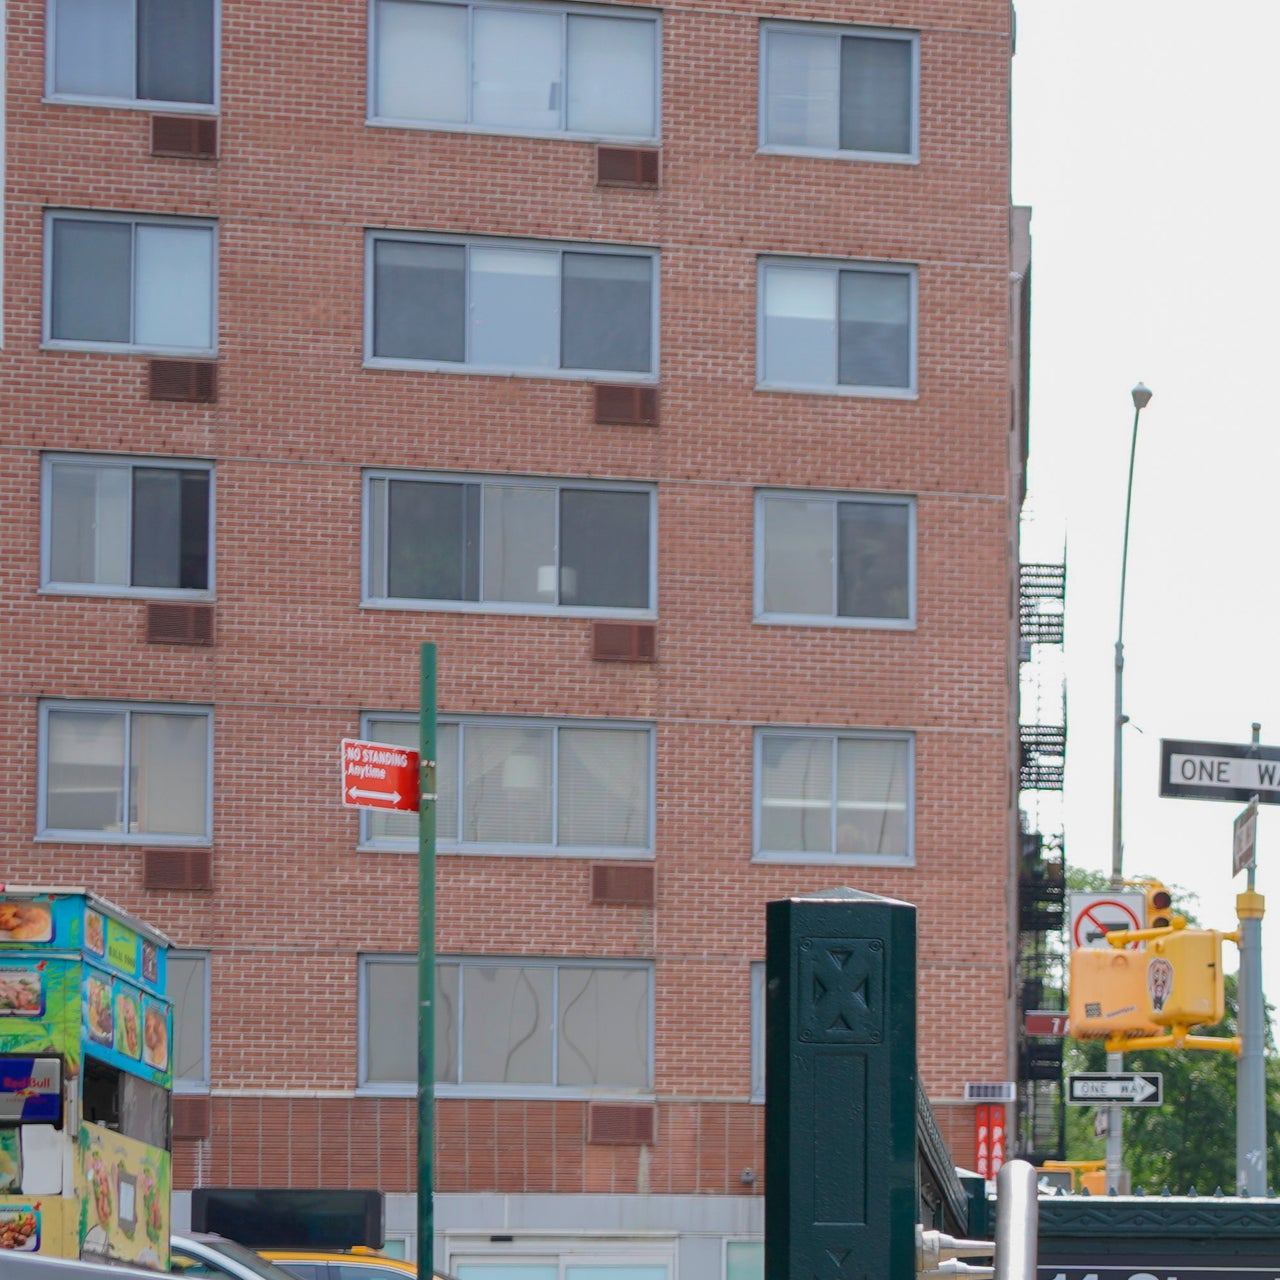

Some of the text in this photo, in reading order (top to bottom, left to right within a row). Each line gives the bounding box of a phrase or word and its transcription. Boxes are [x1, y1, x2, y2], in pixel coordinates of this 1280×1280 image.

[346, 747, 408, 767] NO STANDING
[348, 762, 386, 779] Anytime
[1181, 759, 1231, 783] ONE
[3, 1076, 51, 1089] Red Bull
[1080, 1082, 1146, 1095] ONE WAY
[977, 1126, 988, 1180] PAR
[992, 1126, 1003, 1178] PAR
